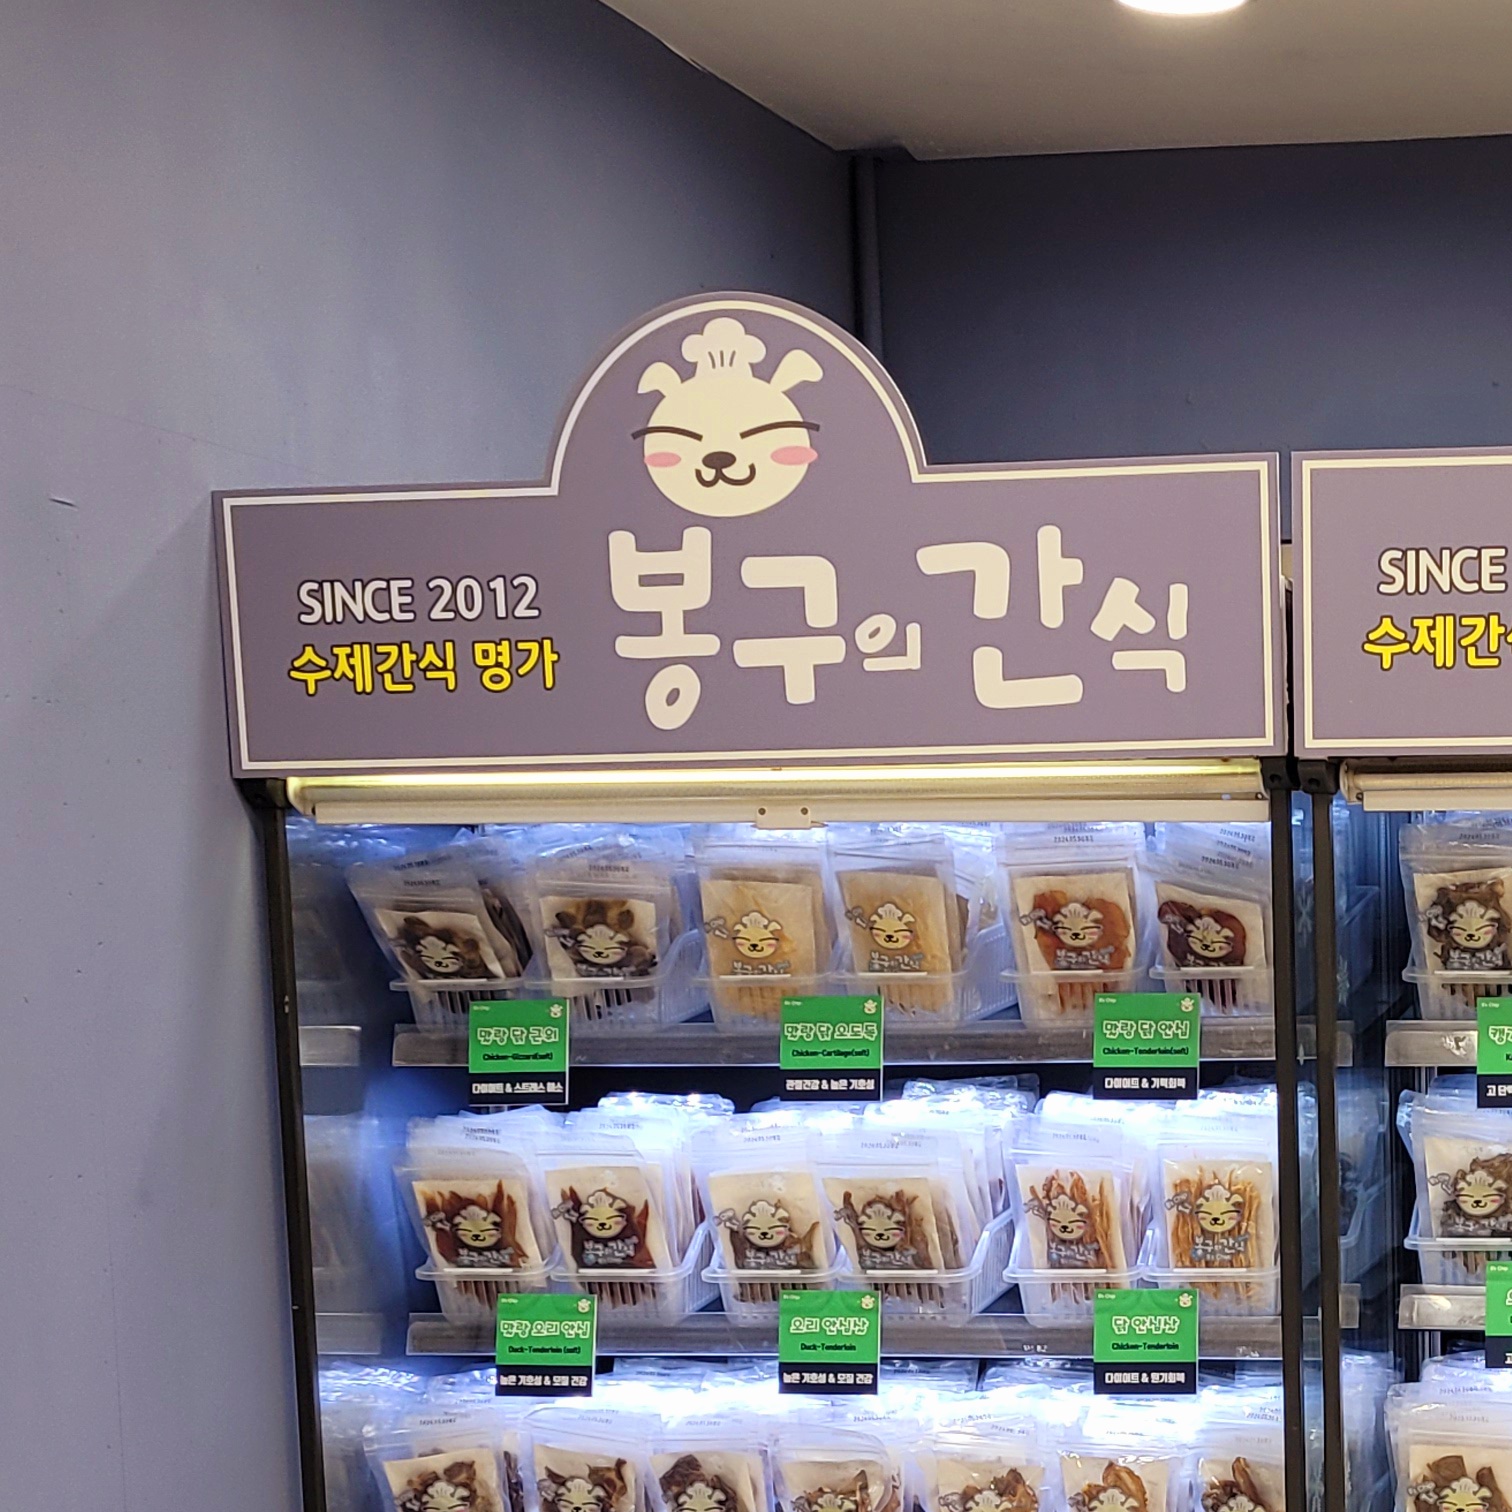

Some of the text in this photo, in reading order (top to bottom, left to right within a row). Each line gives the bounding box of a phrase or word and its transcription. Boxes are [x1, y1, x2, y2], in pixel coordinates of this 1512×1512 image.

[1378, 546, 1506, 594] SINCE
[297, 574, 540, 623] SINCE 2012
[608, 524, 1189, 730] 봉구의 간식
[288, 637, 558, 695] 수제간식 명가
[784, 1023, 815, 1041] 말랑
[834, 1022, 878, 1041] 오도독
[1103, 1020, 1189, 1039] 말랑 닭 안심
[501, 1320, 590, 1338] 말랑 오리 안심
[790, 1317, 869, 1335] 오리 안심살
[1112, 1316, 1180, 1334] 닭 안심살
